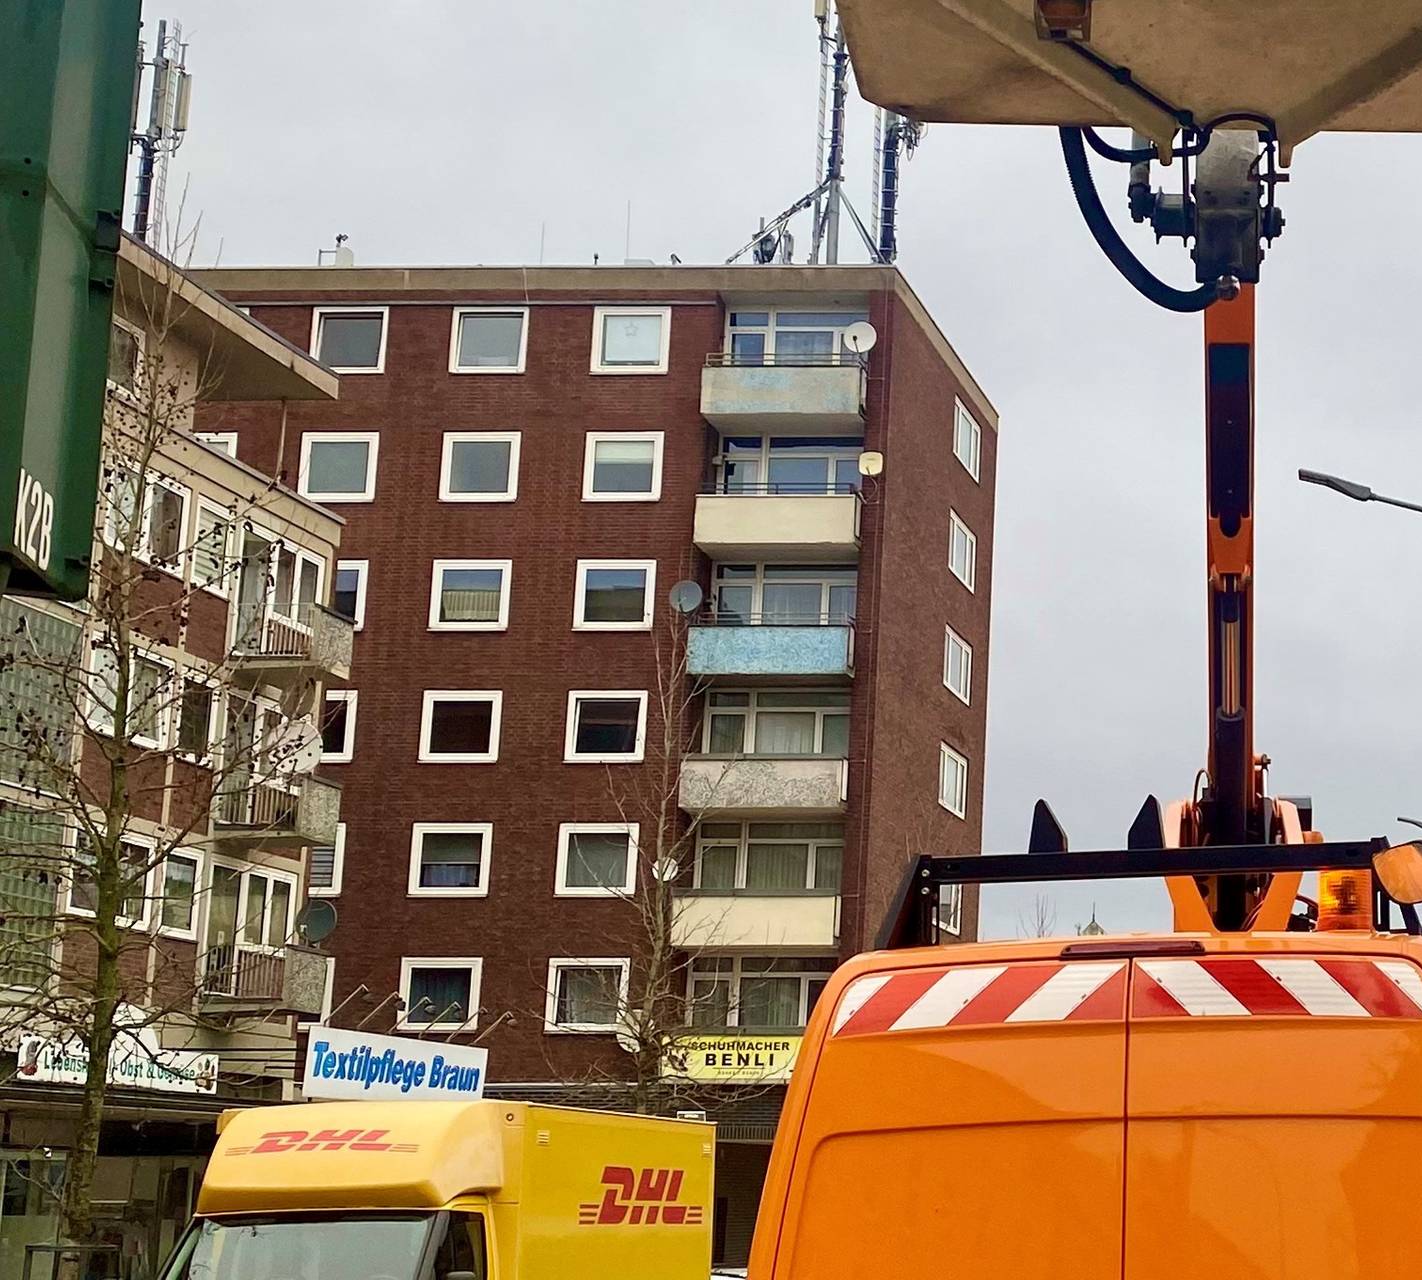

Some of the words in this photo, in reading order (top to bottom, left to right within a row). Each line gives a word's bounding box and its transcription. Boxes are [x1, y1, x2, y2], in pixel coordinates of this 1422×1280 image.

[14, 468, 54, 571] K2B
[691, 1041, 790, 1051] SCHUHMACHER
[705, 1053, 774, 1066] BENLI
[44, 1050, 89, 1075] Lebens
[120, 1058, 143, 1078] Obst
[158, 1065, 196, 1081] Gese
[313, 1041, 426, 1093] Textilpflege
[428, 1055, 480, 1092] Braun
[251, 1129, 393, 1153] DHL
[599, 1166, 688, 1225] DHL
